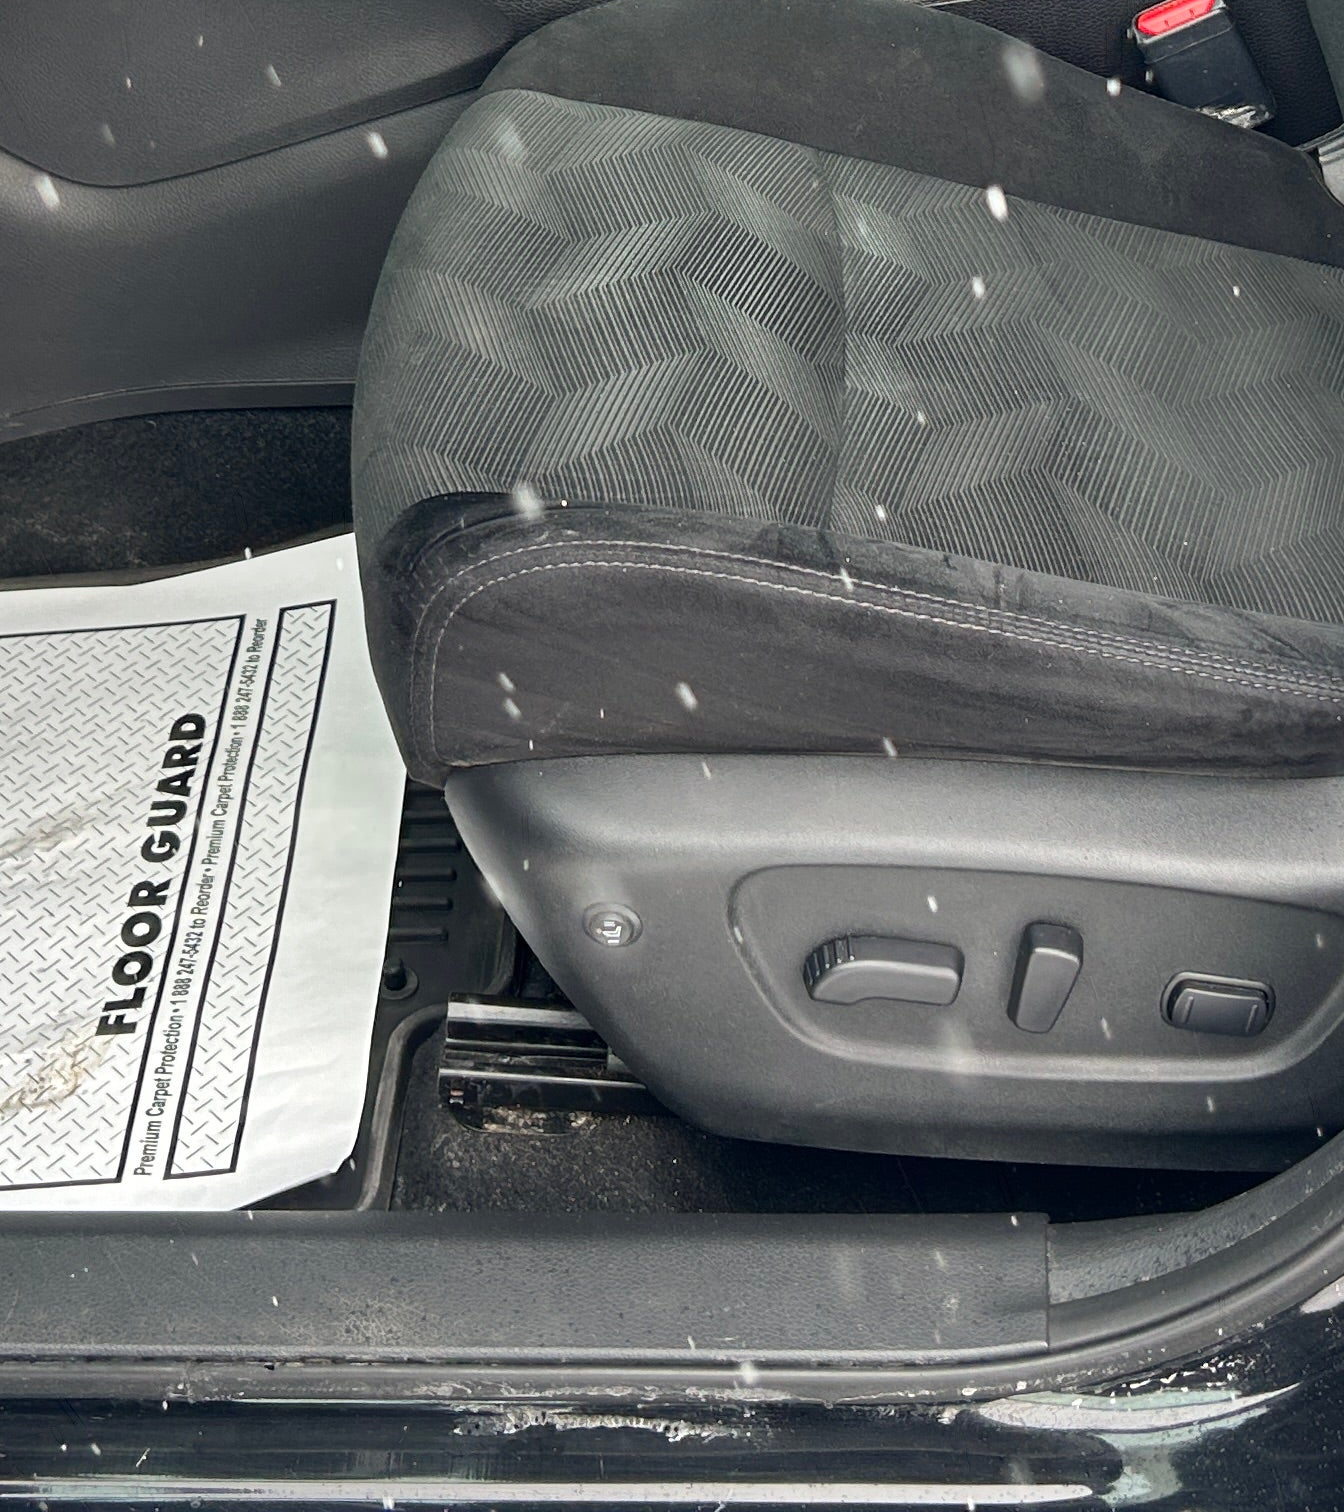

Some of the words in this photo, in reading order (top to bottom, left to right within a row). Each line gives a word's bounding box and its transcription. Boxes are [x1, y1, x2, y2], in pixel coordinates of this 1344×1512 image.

[247, 618, 268, 654] Reorder
[245, 652, 260, 663] to
[238, 662, 258, 703] 247-5432
[232, 704, 250, 722] 888
[218, 736, 244, 783] Protection
[211, 779, 235, 816] Carpet
[202, 819, 226, 865] Premium
[95, 879, 172, 1036] FLOOR
[140, 713, 206, 863] GUARD
[191, 874, 216, 916] Reorder
[189, 918, 206, 931] to
[178, 930, 204, 975] 247-5432
[170, 998, 187, 1006] 1
[172, 977, 192, 997] 888
[155, 1014, 184, 1074] Protection
[146, 1077, 173, 1117] Carpet
[133, 1120, 162, 1175] Premium
